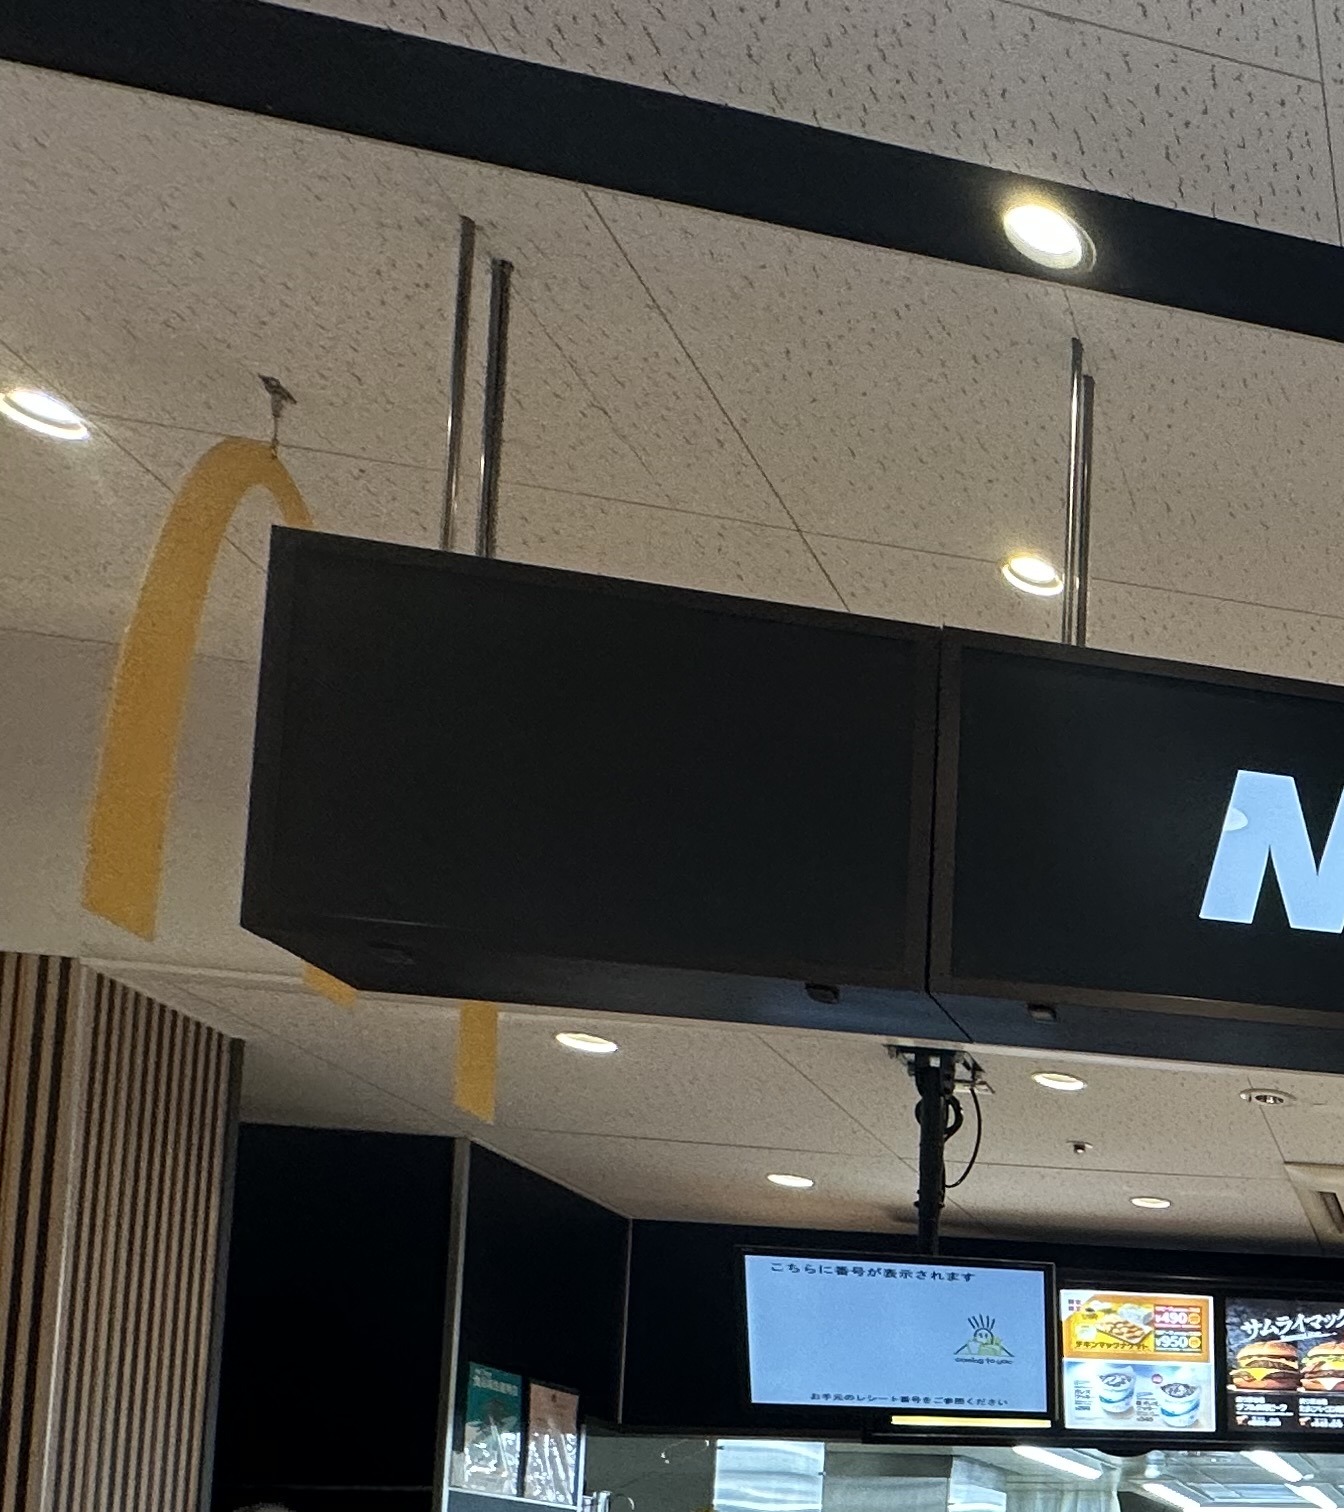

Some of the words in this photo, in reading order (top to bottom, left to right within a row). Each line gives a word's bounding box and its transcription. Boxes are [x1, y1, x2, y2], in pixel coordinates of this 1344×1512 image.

[770, 1262, 976, 1283] こちらに番号が表示されます
